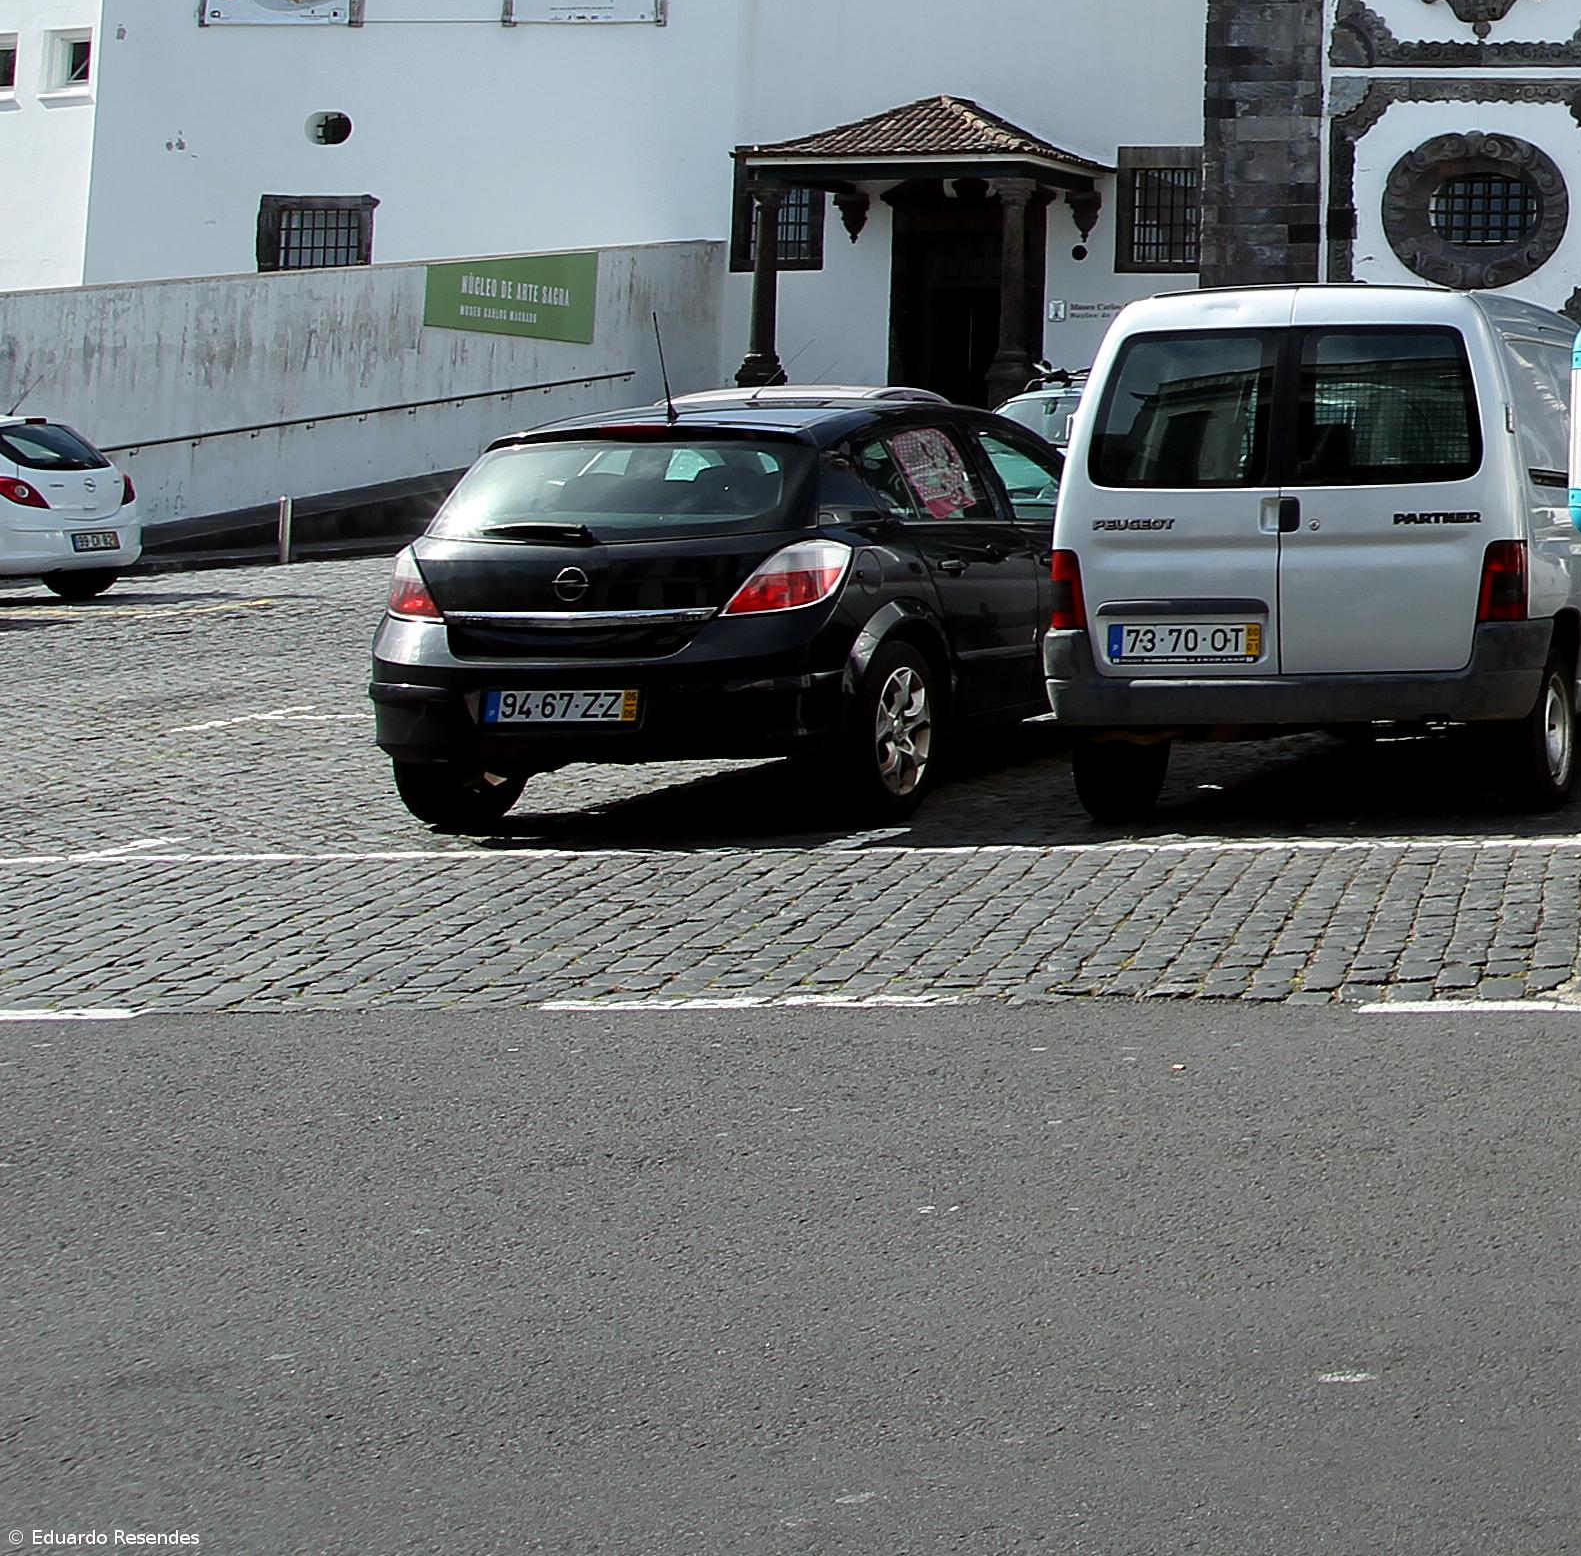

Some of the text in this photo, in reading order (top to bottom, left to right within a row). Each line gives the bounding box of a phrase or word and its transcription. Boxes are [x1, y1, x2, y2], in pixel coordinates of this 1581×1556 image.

[461, 272, 570, 307] NÚCLEO DE ARTE SACRA
[1393, 511, 1482, 524] PARTNER
[1092, 518, 1175, 531] PEUGEOT
